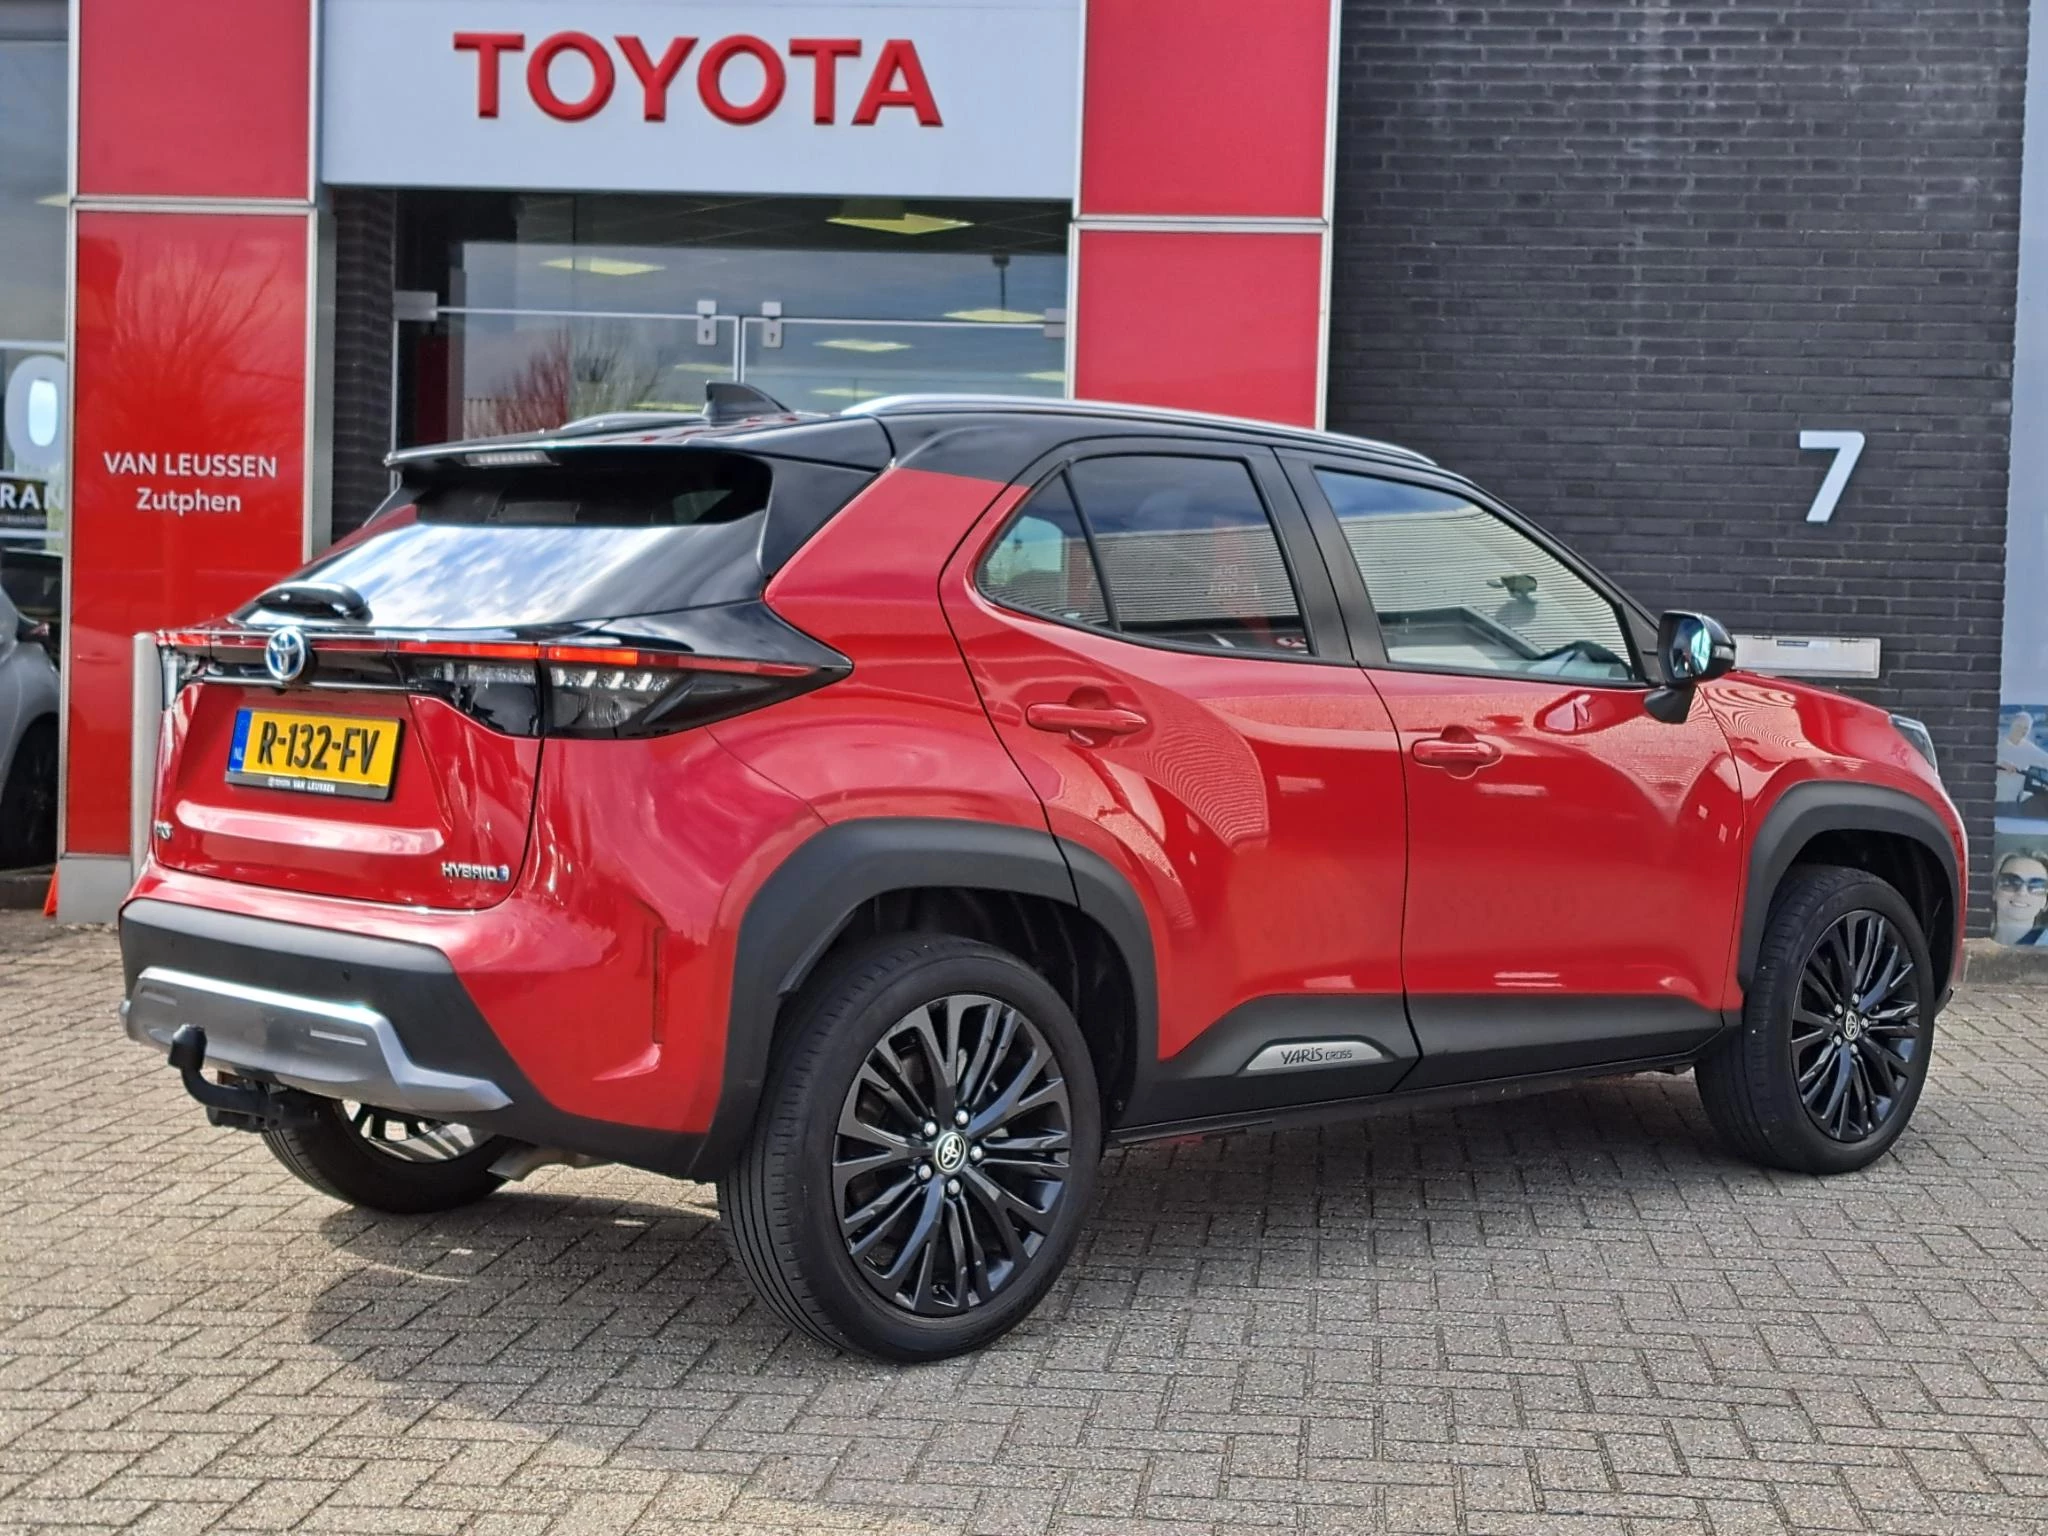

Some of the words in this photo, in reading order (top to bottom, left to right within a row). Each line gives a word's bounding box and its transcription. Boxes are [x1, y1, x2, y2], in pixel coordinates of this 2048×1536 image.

[453, 31, 945, 127] TOYOTA
[103, 451, 157, 475] VAN
[164, 453, 278, 479] LEUSSEN
[1799, 429, 1866, 523] 7
[136, 487, 242, 517] Zutphen
[257, 721, 381, 775] R-132-FV
[440, 861, 499, 881] HYBRID
[1280, 1047, 1323, 1065] YARIS
[1325, 1049, 1353, 1061] CROSS
